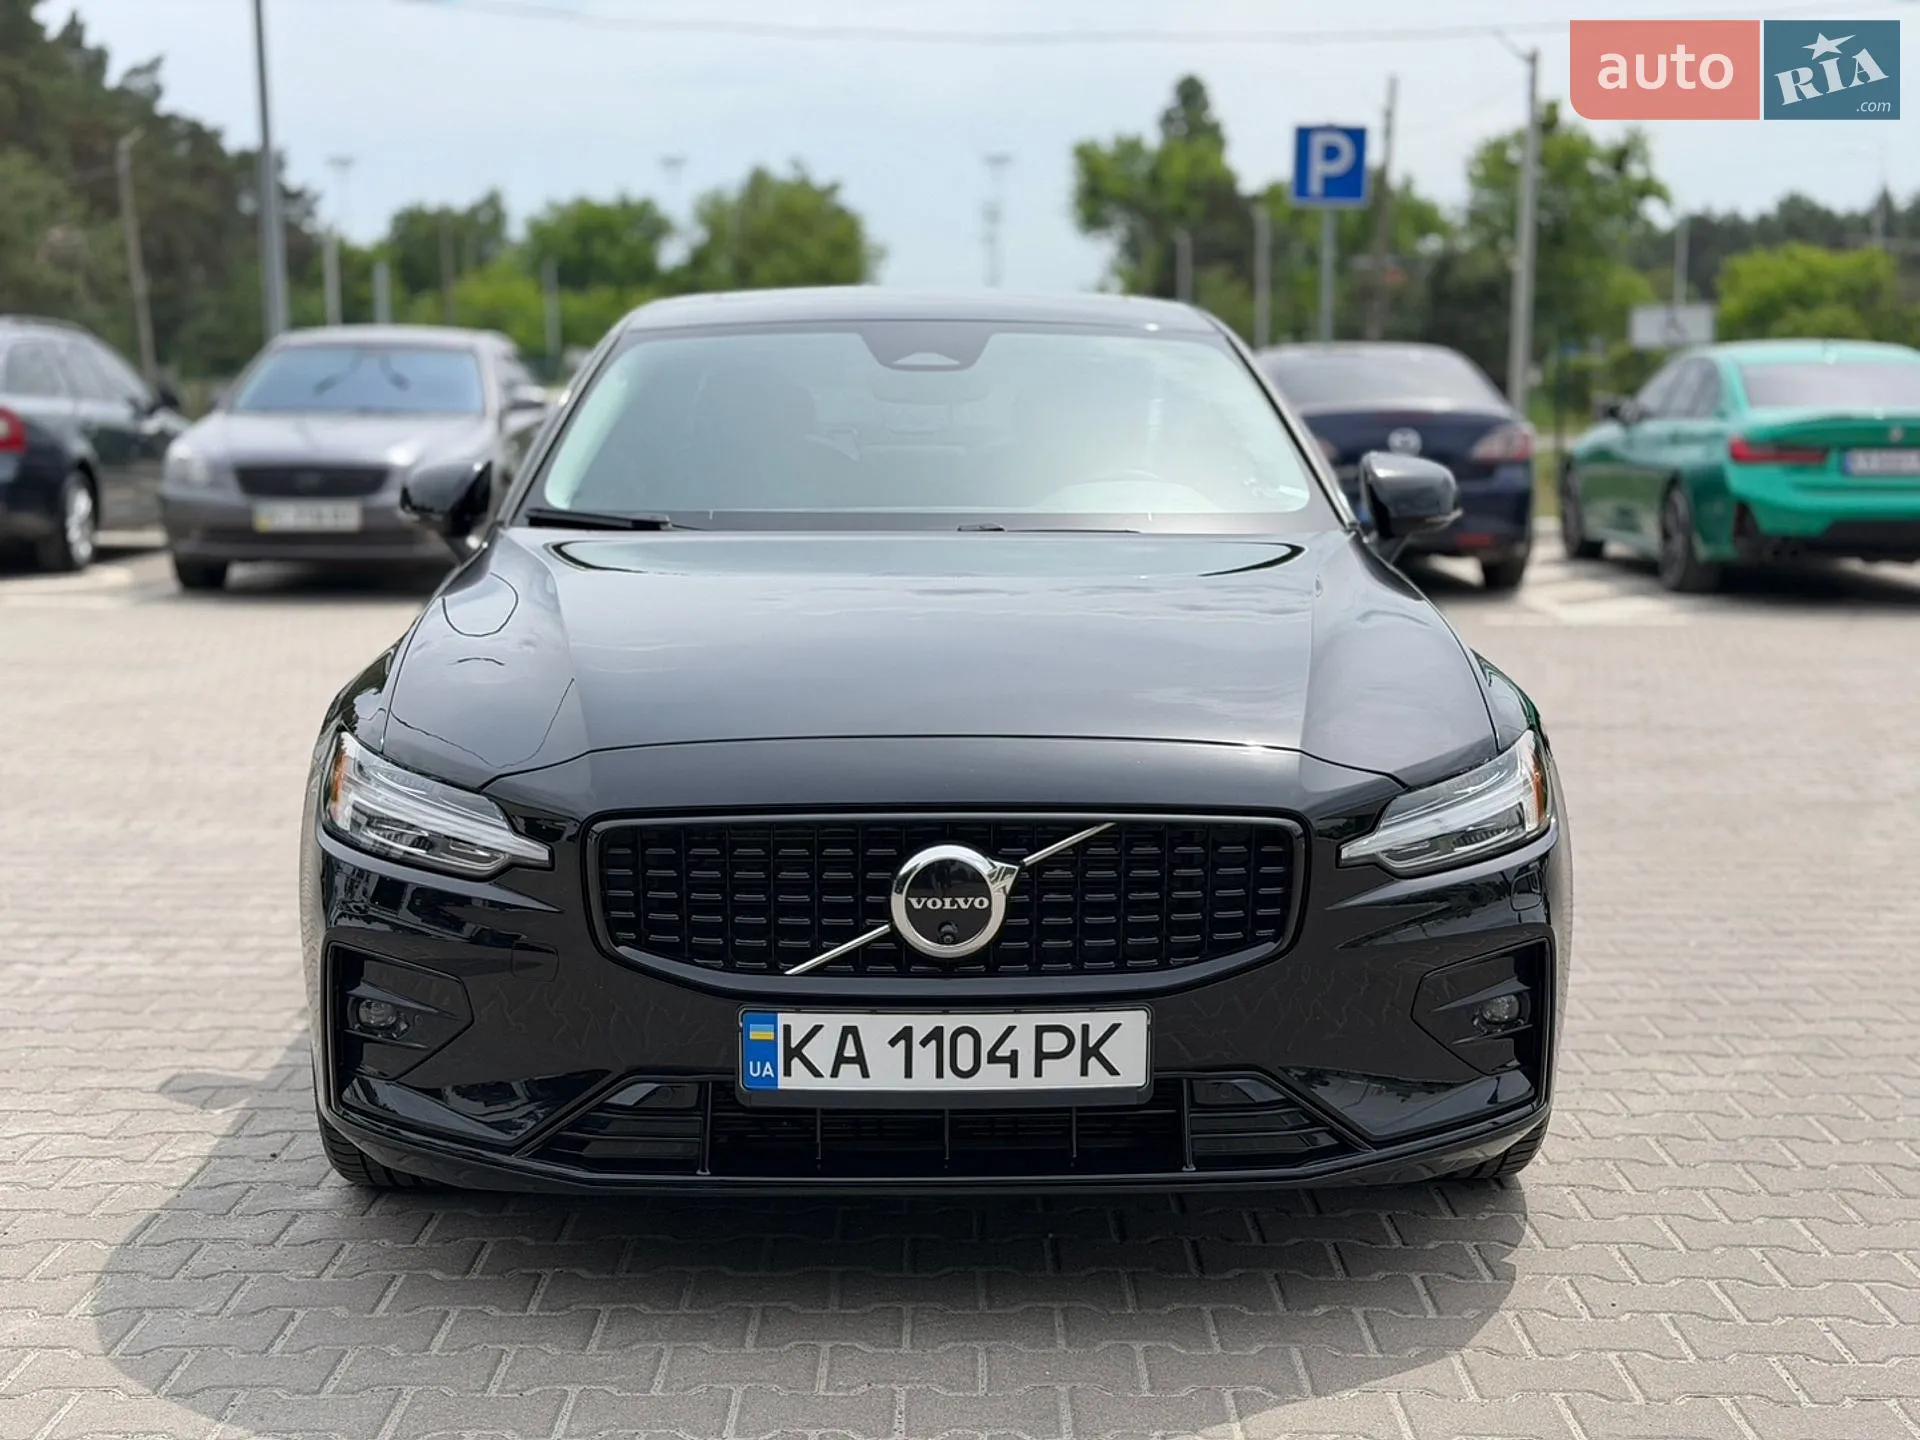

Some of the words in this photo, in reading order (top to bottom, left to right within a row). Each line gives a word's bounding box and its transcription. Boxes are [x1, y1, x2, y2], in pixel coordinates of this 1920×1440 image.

[1308, 131, 1356, 196] P
[907, 896, 990, 910] VOLVO
[749, 1060, 775, 1078] UA
[782, 1023, 871, 1079] KA
[887, 1025, 1019, 1079] 1104
[1033, 1022, 1123, 1078] PK
